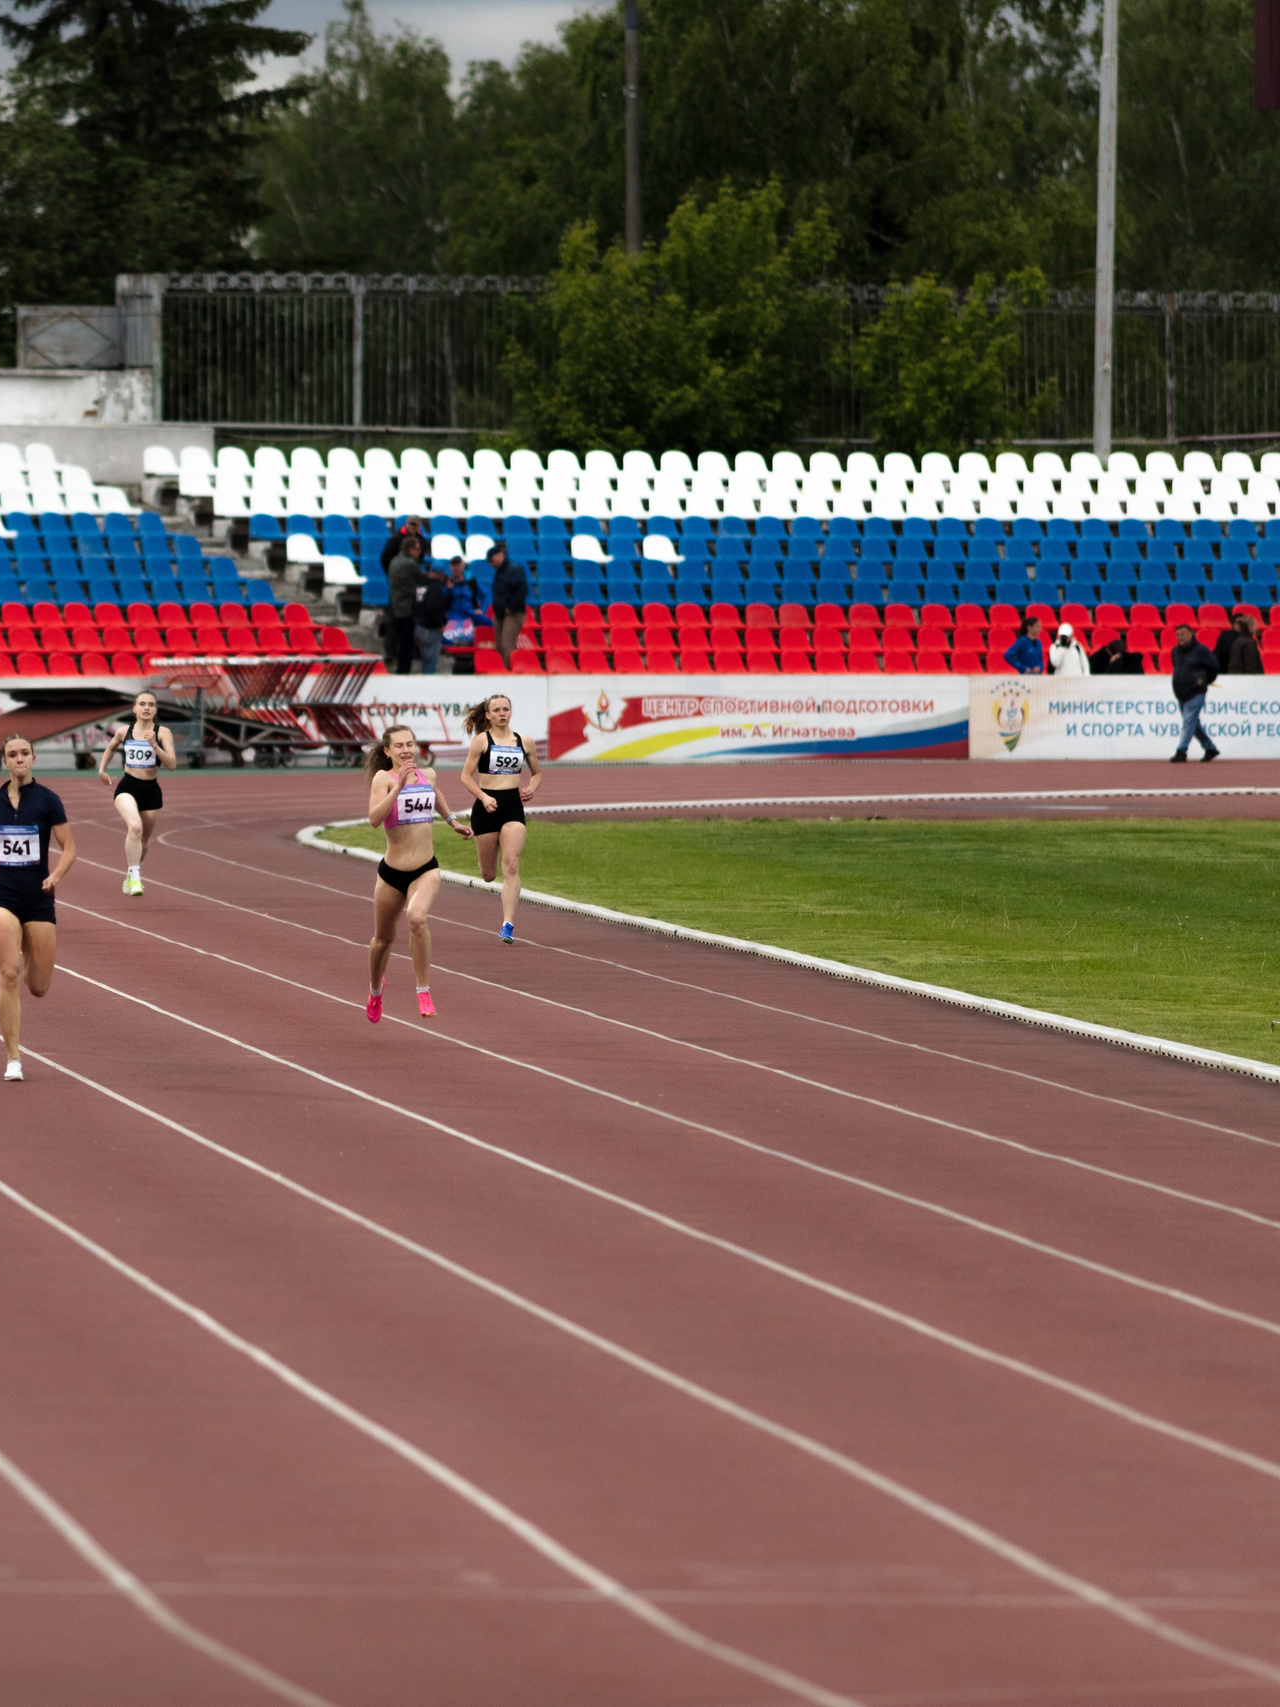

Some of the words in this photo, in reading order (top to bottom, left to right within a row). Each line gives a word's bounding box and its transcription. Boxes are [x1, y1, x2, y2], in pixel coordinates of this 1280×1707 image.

[642, 699, 698, 718] ЦЕНТР
[701, 697, 816, 714] СПОРТИВНОЙ
[821, 699, 934, 715] ПОДГОТОВКИ
[1048, 700, 1178, 715] МИНИСТЕРСТВО
[721, 728, 746, 738] им.
[752, 725, 767, 738] А.
[772, 725, 856, 739] Игнатьева
[1066, 723, 1077, 736] И
[1081, 723, 1144, 736] СПОРТА
[1149, 720, 1251, 736] ЧУВСКОЙ
[129, 749, 152, 761] 309
[496, 756, 519, 768] 592
[404, 797, 433, 814] 544
[3, 840, 31, 856] 541
